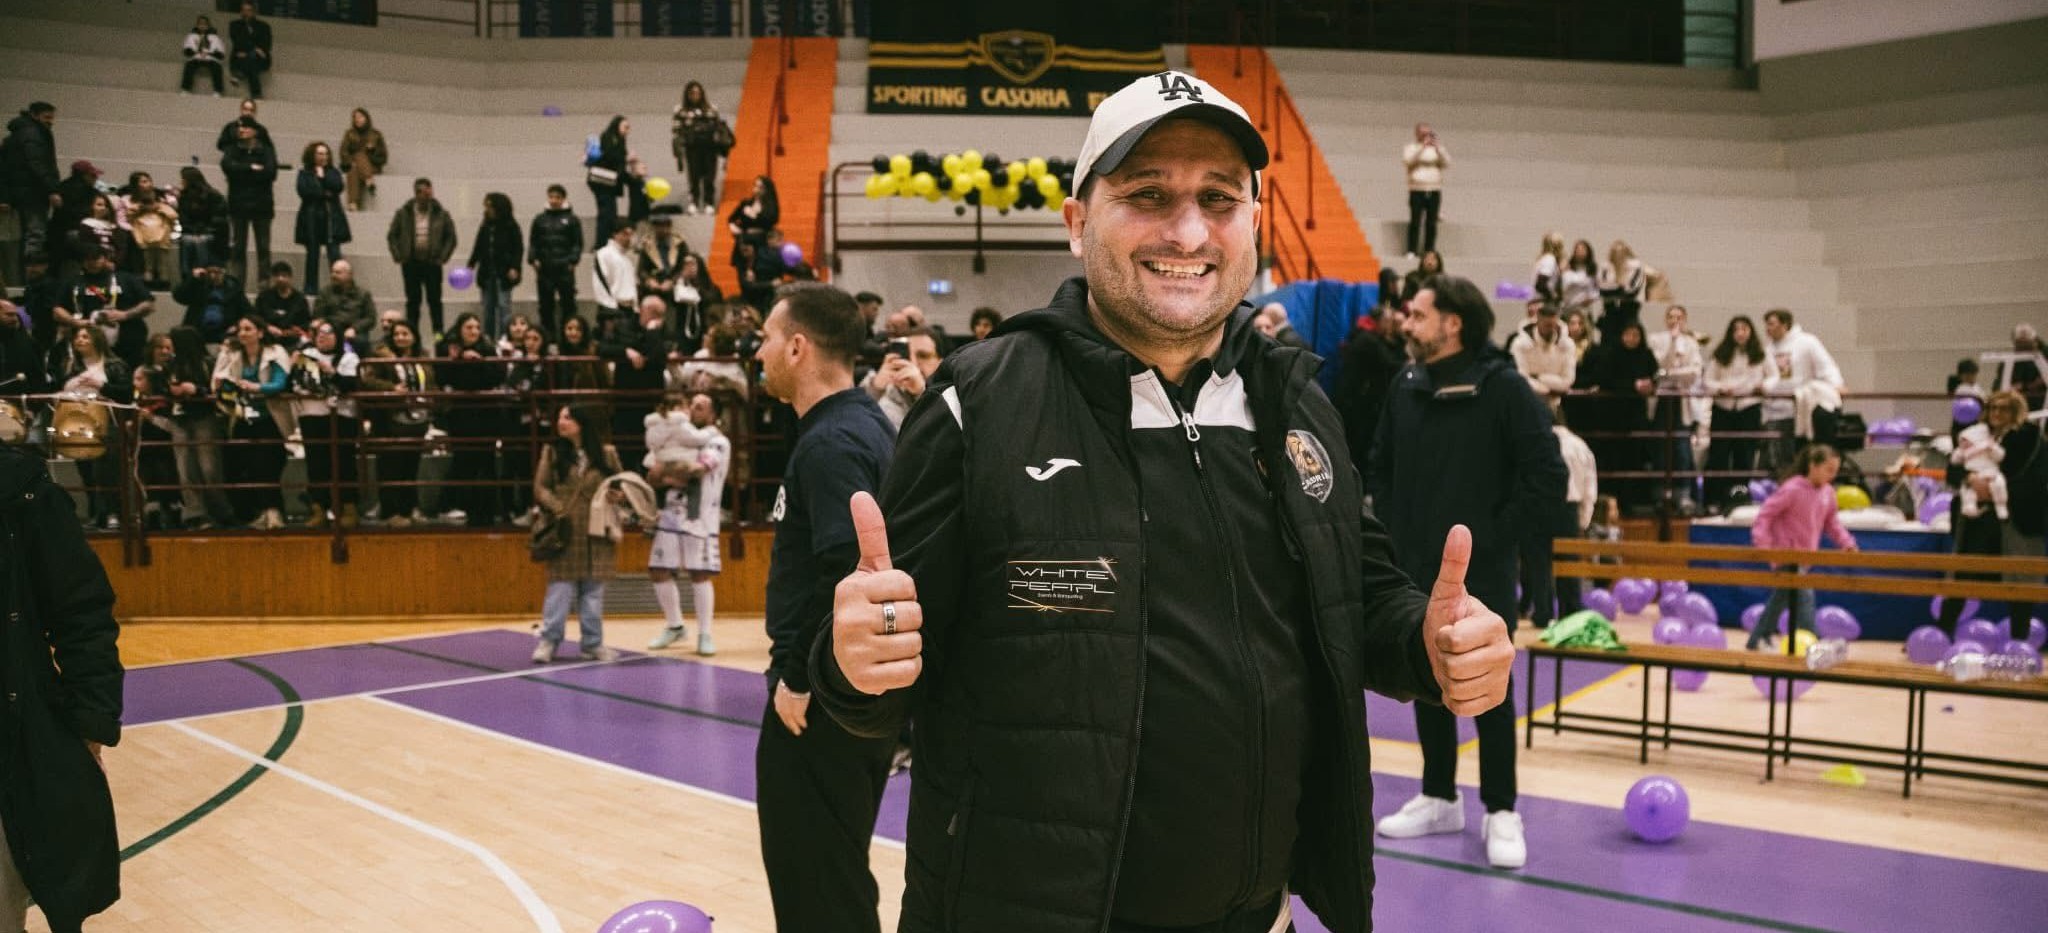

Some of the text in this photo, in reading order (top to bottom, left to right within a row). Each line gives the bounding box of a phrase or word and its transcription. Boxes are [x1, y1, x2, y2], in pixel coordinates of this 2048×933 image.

[873, 85, 968, 108] SPORTING
[981, 86, 1072, 109] CASORIA
[1154, 71, 1205, 103] LA
[1015, 566, 1110, 580] WHITE
